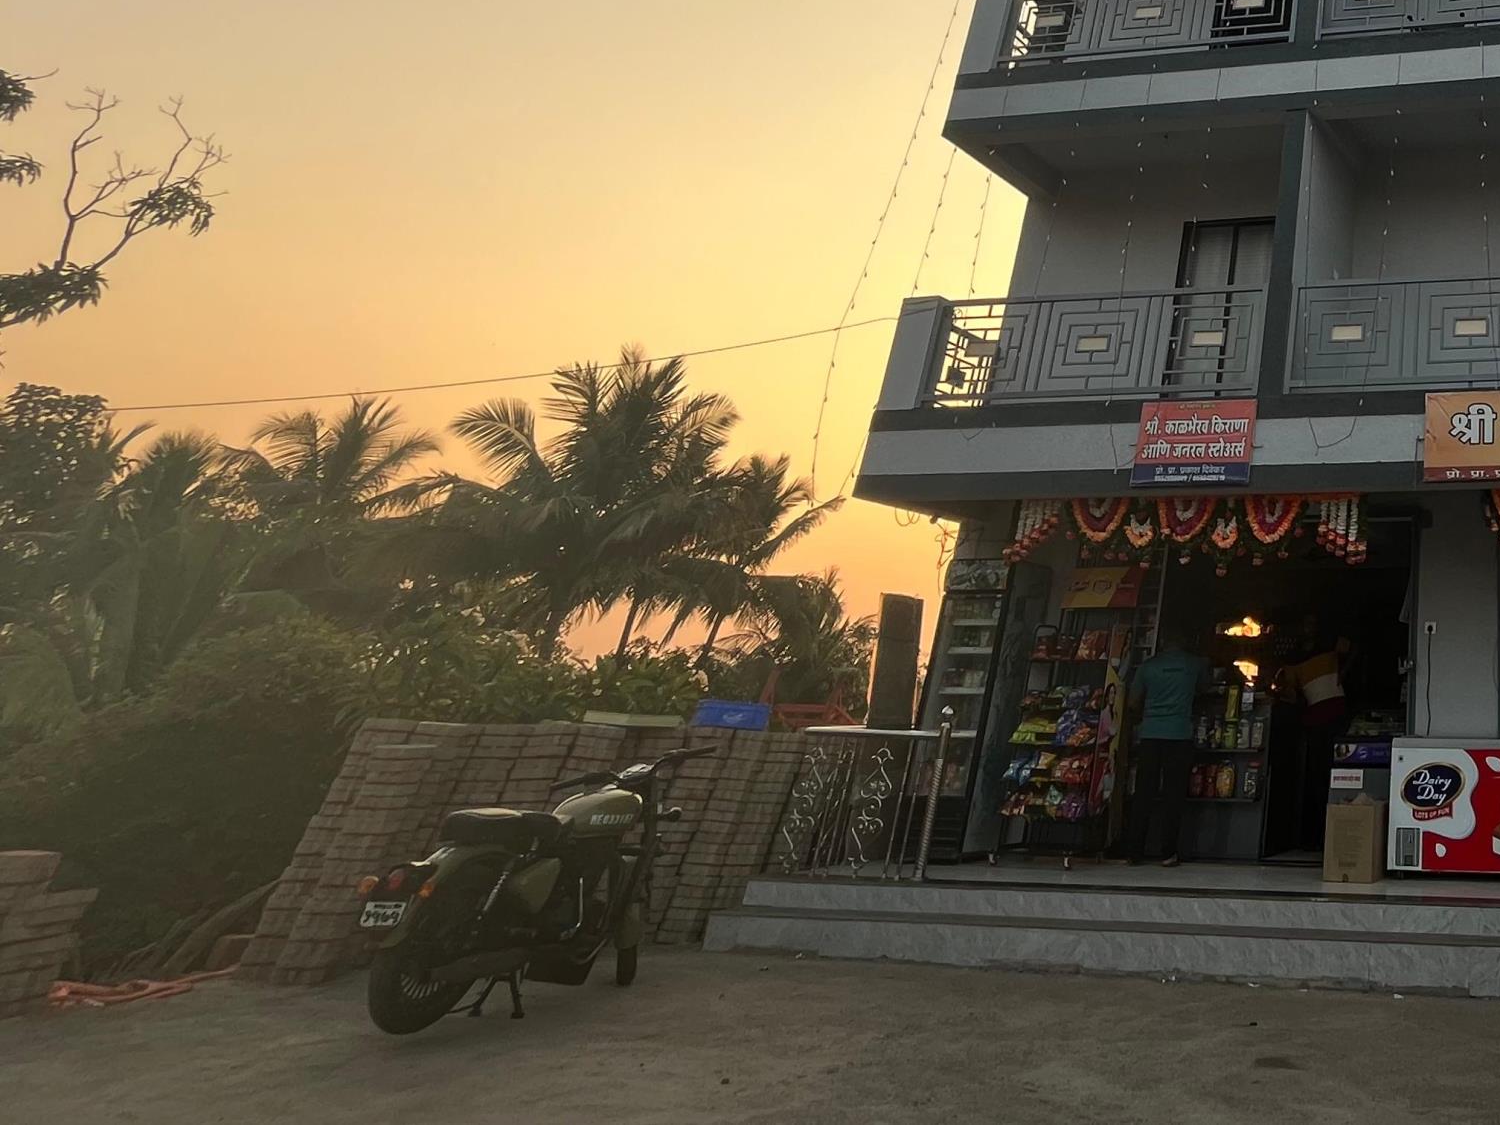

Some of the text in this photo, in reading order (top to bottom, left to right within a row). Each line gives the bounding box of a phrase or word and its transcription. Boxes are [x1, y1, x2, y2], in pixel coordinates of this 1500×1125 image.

[1210, 415, 1250, 435] किराणा
[1449, 403, 1497, 444] श्री
[1141, 439, 1171, 459] आणि
[1172, 442, 1205, 458] जनरल
[1413, 769, 1452, 791] Dairy
[1416, 784, 1447, 806] Day
